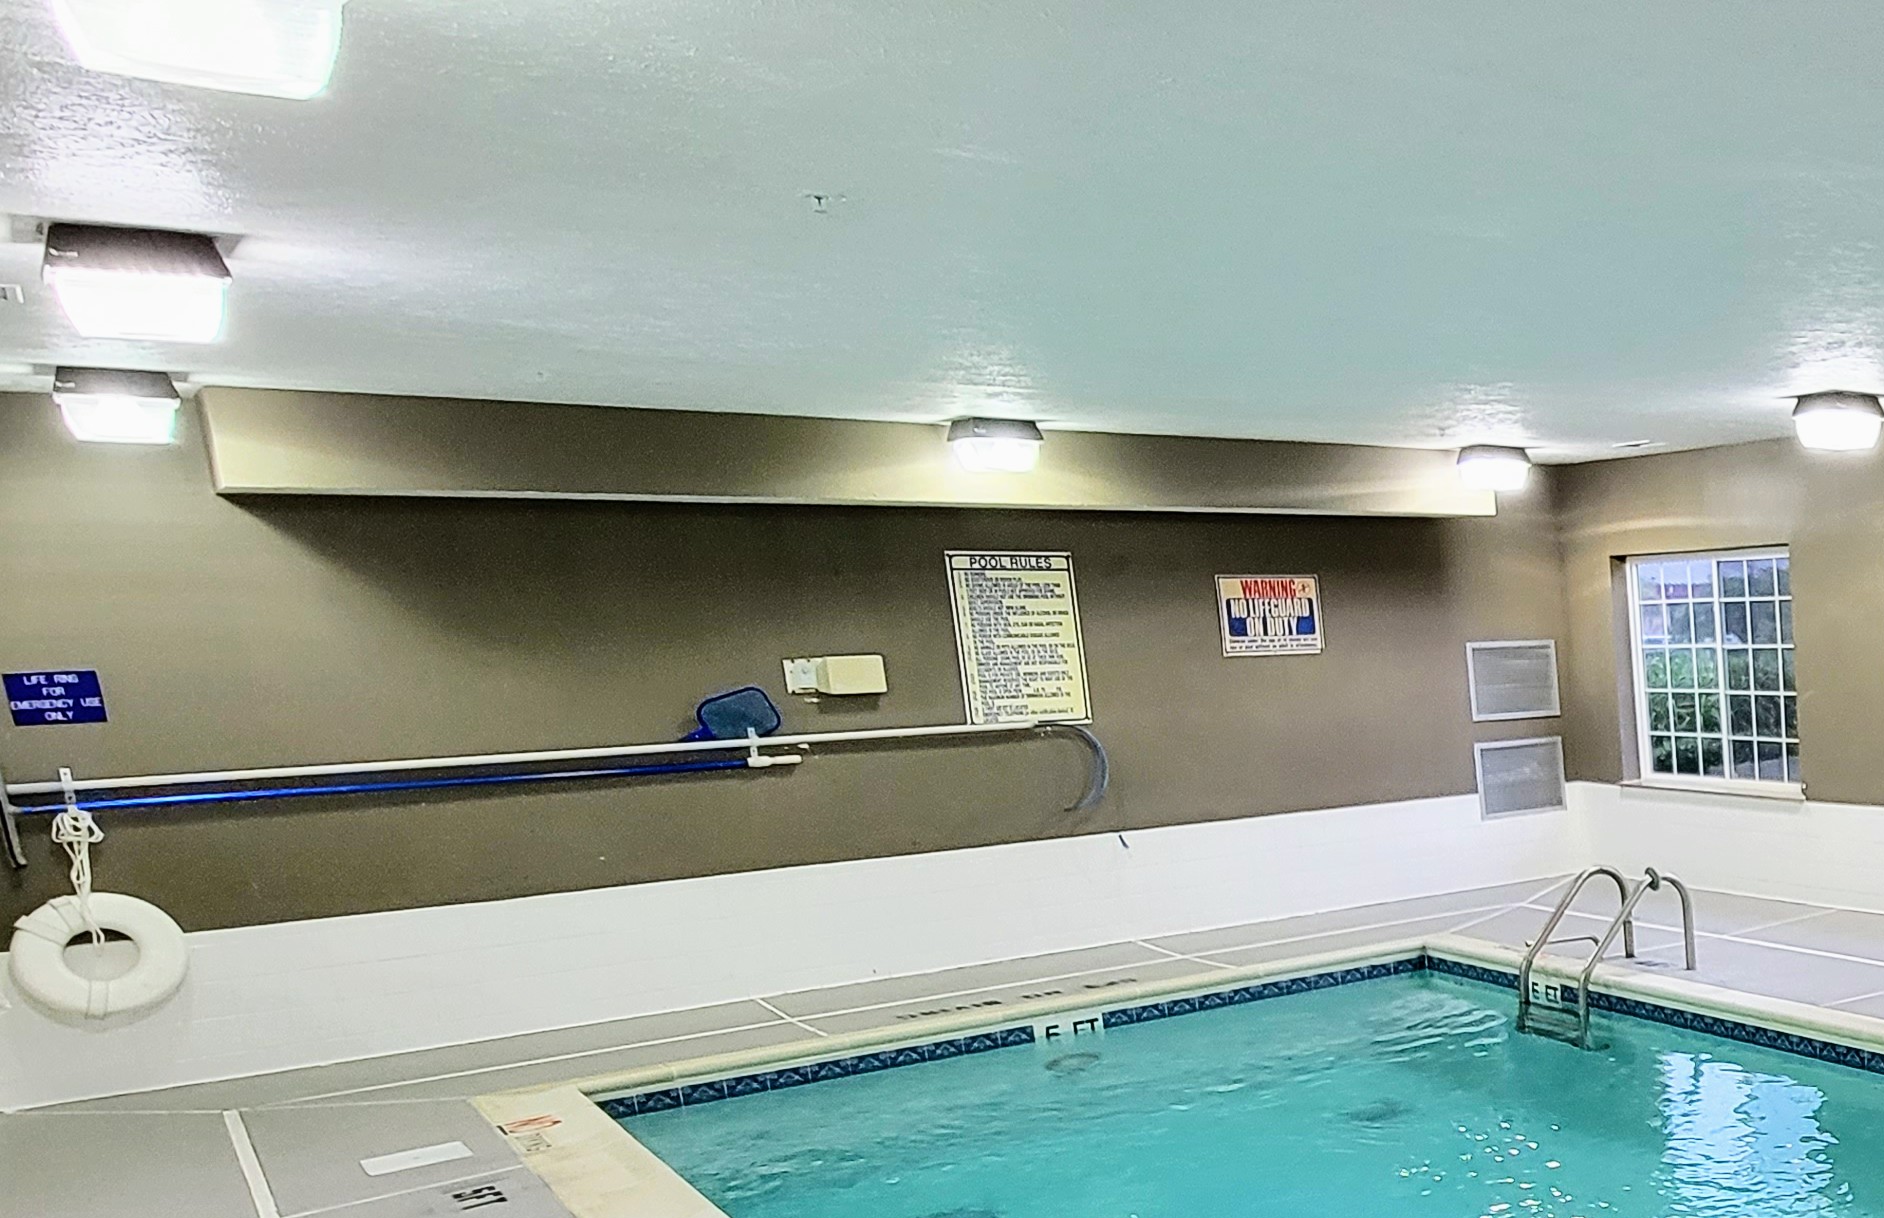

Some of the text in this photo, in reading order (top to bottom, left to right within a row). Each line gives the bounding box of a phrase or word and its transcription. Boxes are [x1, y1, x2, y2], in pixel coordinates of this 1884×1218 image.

[969, 556, 1053, 570] POOL RULES
[1240, 579, 1297, 598] WARNING
[1231, 598, 1310, 618] NO LIFEGUARD
[1246, 617, 1298, 636] ON DUTY
[23, 675, 48, 686] LIFE
[41, 686, 66, 697] FOR
[10, 697, 102, 710] EMERGENCY USE
[44, 711, 73, 721] ONLY
[1072, 1018, 1099, 1035] FT
[452, 1184, 508, 1211] 5FT
